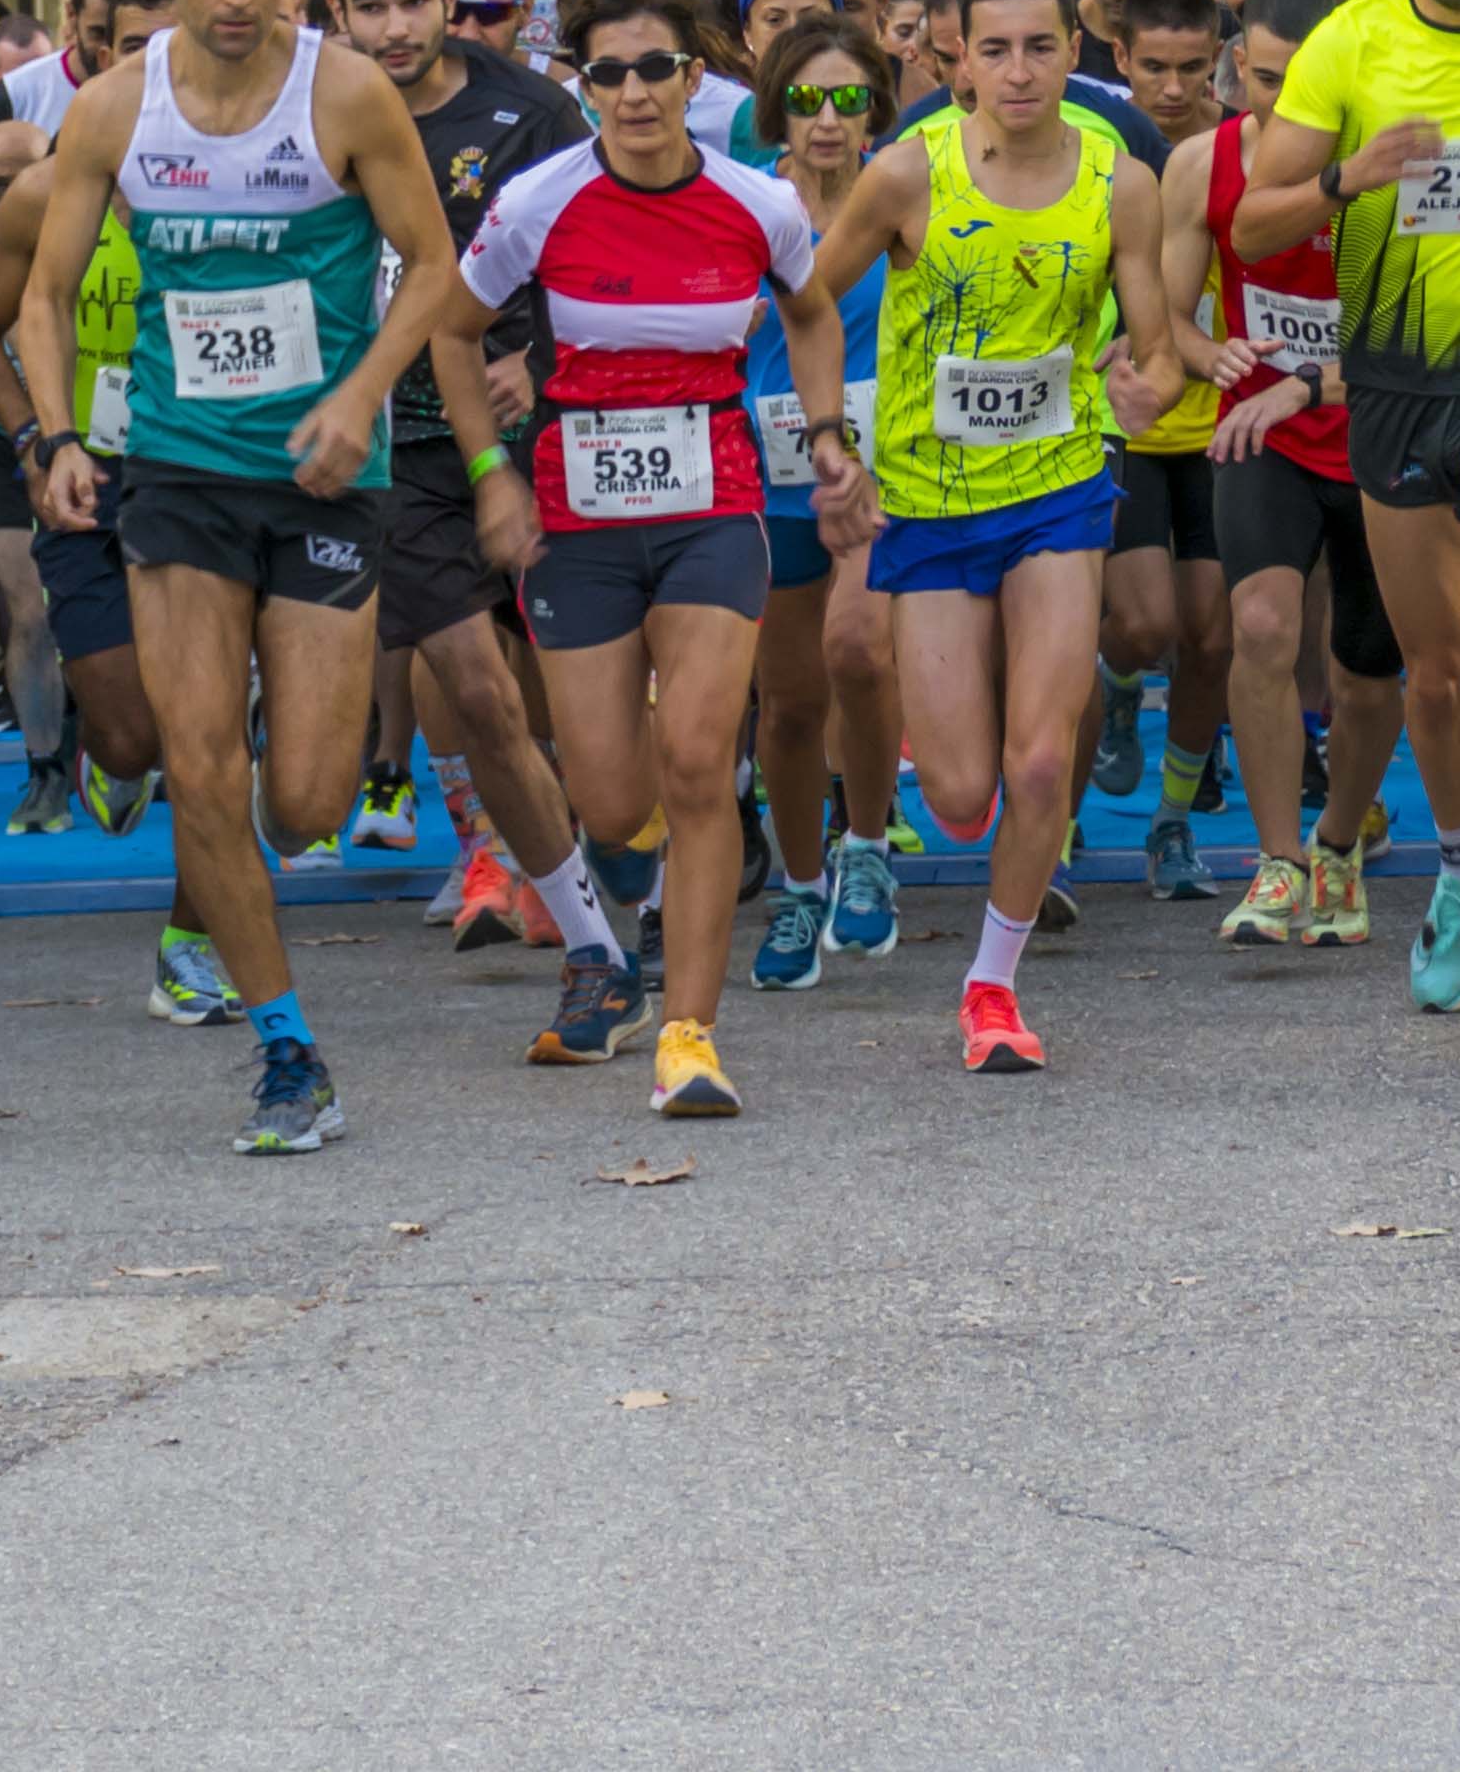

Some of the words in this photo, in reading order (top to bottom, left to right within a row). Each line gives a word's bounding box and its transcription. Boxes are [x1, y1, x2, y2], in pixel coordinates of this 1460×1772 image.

[194, 324, 277, 361] 238
[210, 353, 277, 375] JAVIER
[951, 379, 1050, 414] 1013
[967, 409, 1041, 429] MANUEL
[578, 439, 611, 450] MAST
[593, 445, 672, 481] 539
[594, 476, 683, 495] CRISTINA
